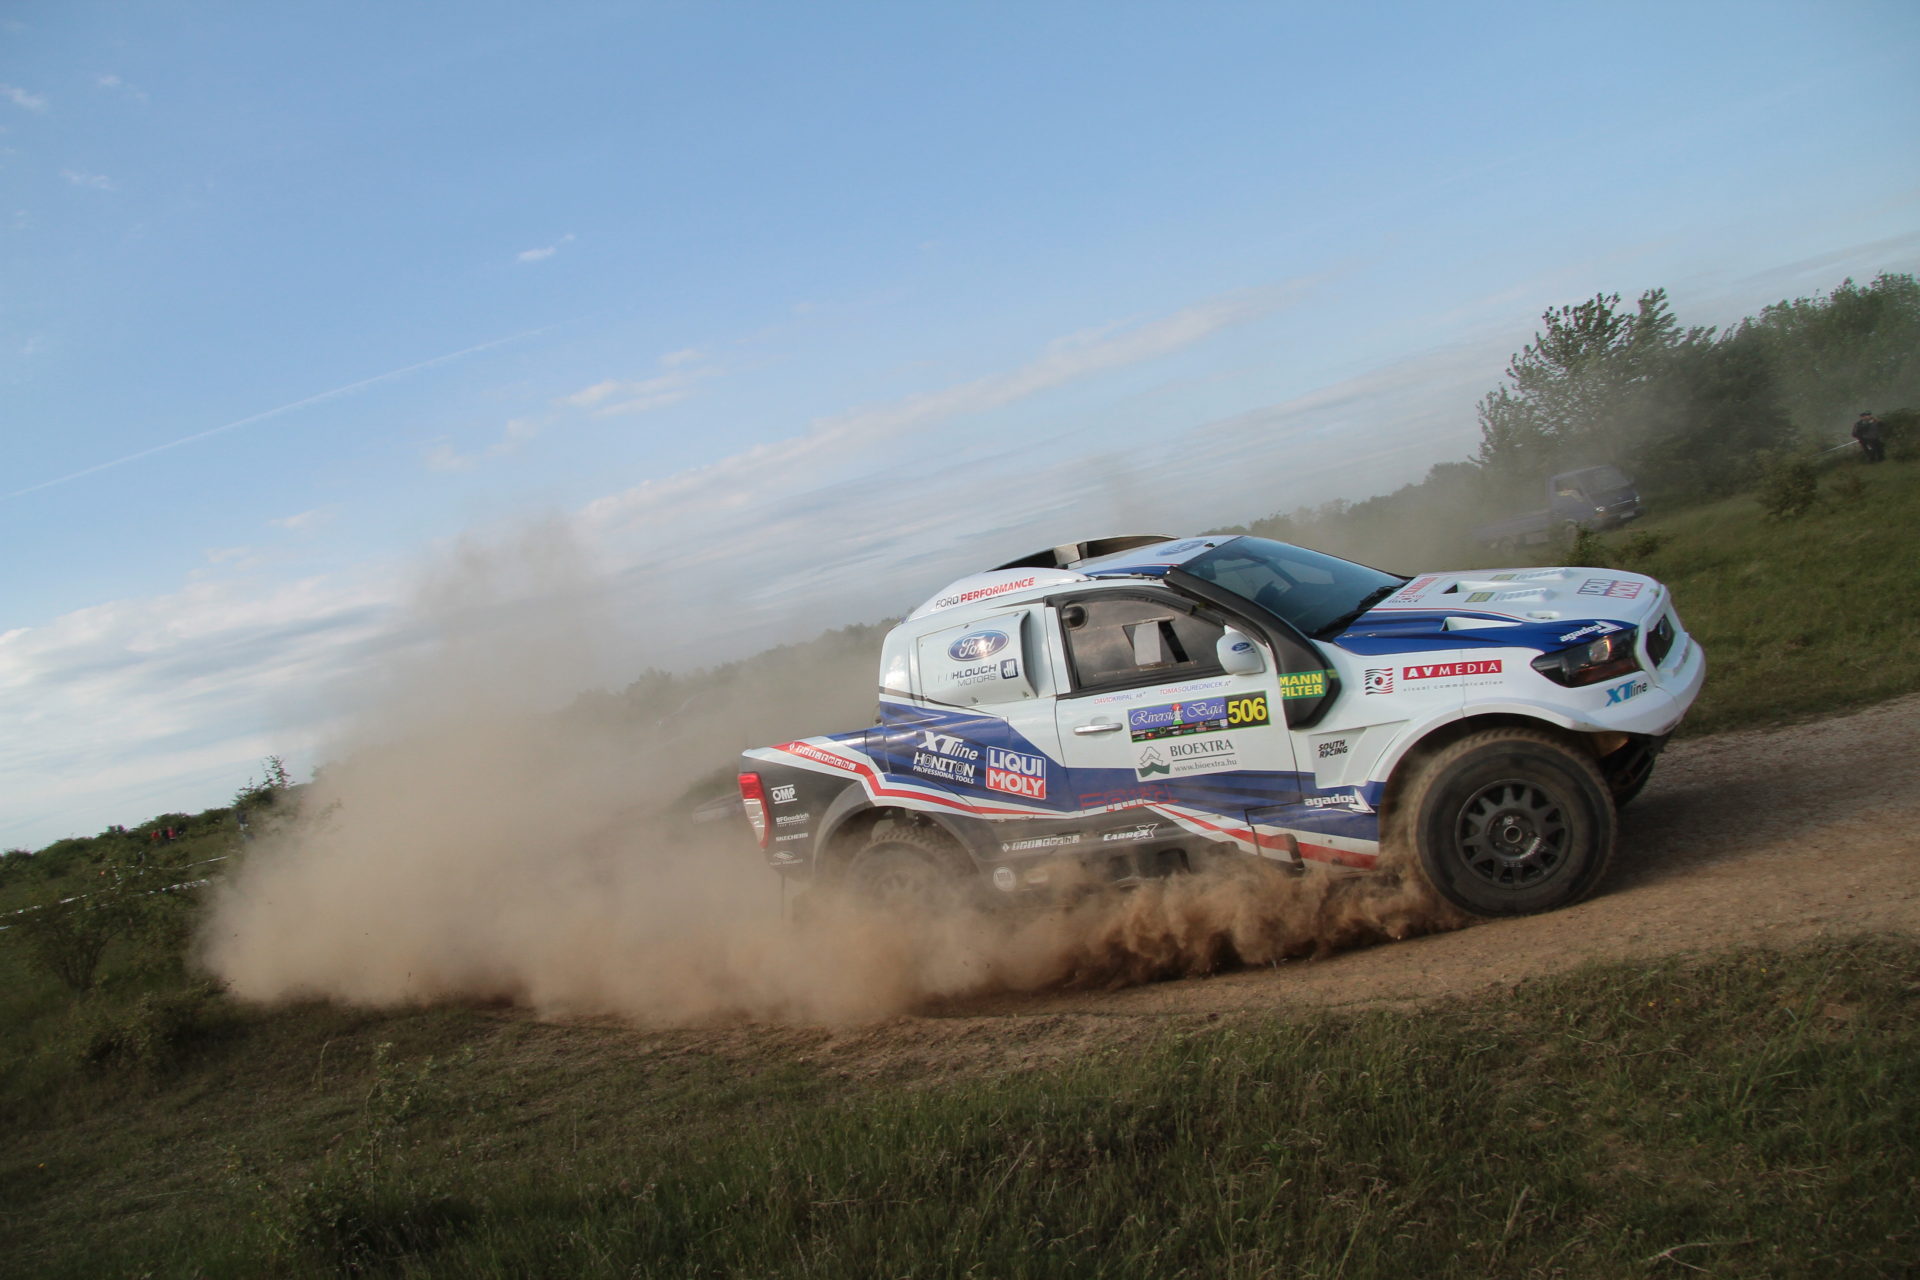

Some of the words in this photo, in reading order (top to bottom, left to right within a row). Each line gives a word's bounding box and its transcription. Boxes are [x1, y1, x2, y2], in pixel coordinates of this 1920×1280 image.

[936, 596, 959, 609] FORD
[960, 577, 1035, 602] PERFORMANCE
[952, 664, 997, 679] HLOUCH
[957, 673, 997, 687] MOTORS
[1279, 673, 1323, 686] MANN
[1280, 684, 1323, 697] FILTER
[1605, 680, 1648, 707] XTline
[1187, 702, 1225, 721] Baja
[1227, 697, 1267, 724] 506
[917, 730, 979, 760] XTline
[1169, 739, 1234, 757] BIOEXTRA
[1318, 739, 1346, 751] SOUTH
[913, 752, 975, 778] HONITON
[989, 749, 1043, 776] LIQUI
[1174, 758, 1238, 772] www.bioextra.hu
[913, 765, 955, 780] PROFESSIONAL
[955, 774, 975, 785] TOOLS
[989, 769, 1043, 796] MOLY
[772, 787, 796, 801] OMP
[1304, 793, 1357, 808] agados
